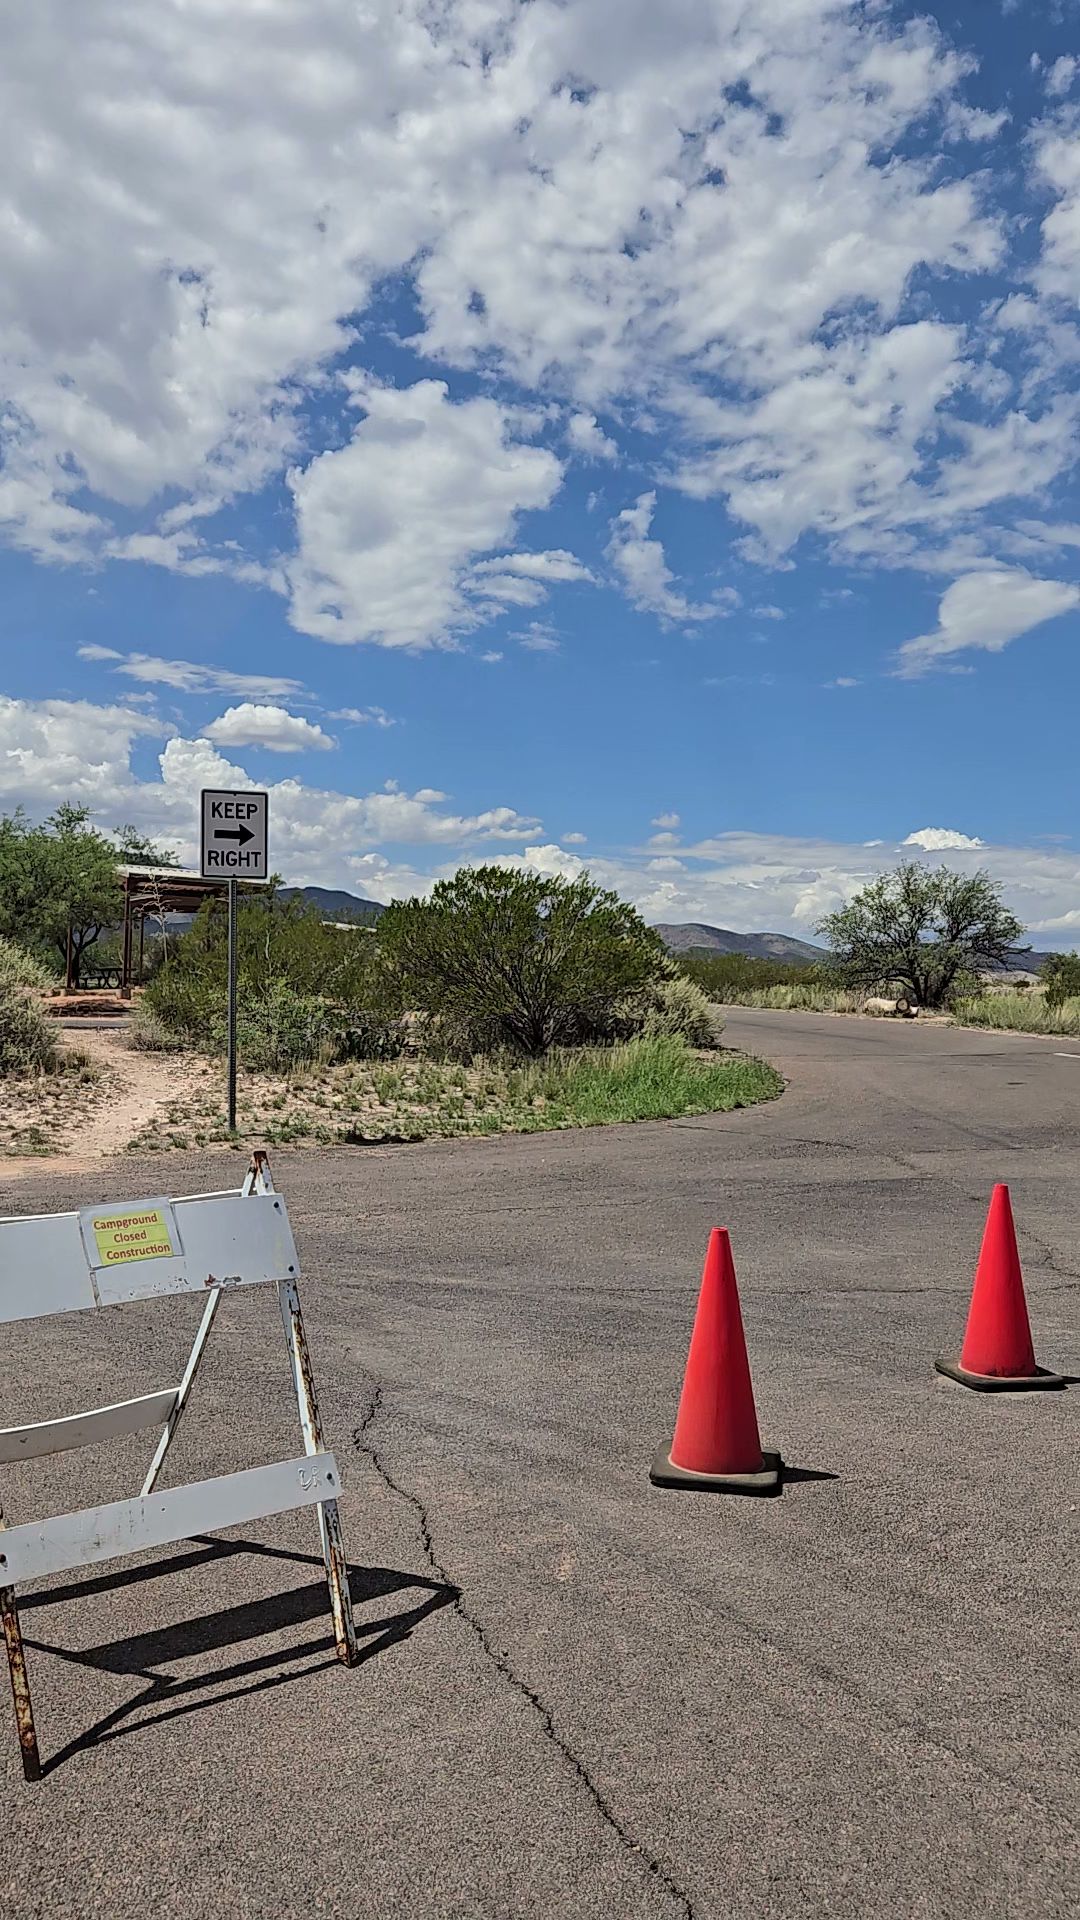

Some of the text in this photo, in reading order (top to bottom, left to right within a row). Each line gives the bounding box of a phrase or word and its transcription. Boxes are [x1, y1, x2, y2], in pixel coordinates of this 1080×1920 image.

[211, 801, 258, 820] KEEP
[207, 849, 262, 868] RIGHT
[93, 1212, 158, 1230] Campground
[113, 1230, 147, 1243] Closed
[106, 1244, 171, 1260] Construction
